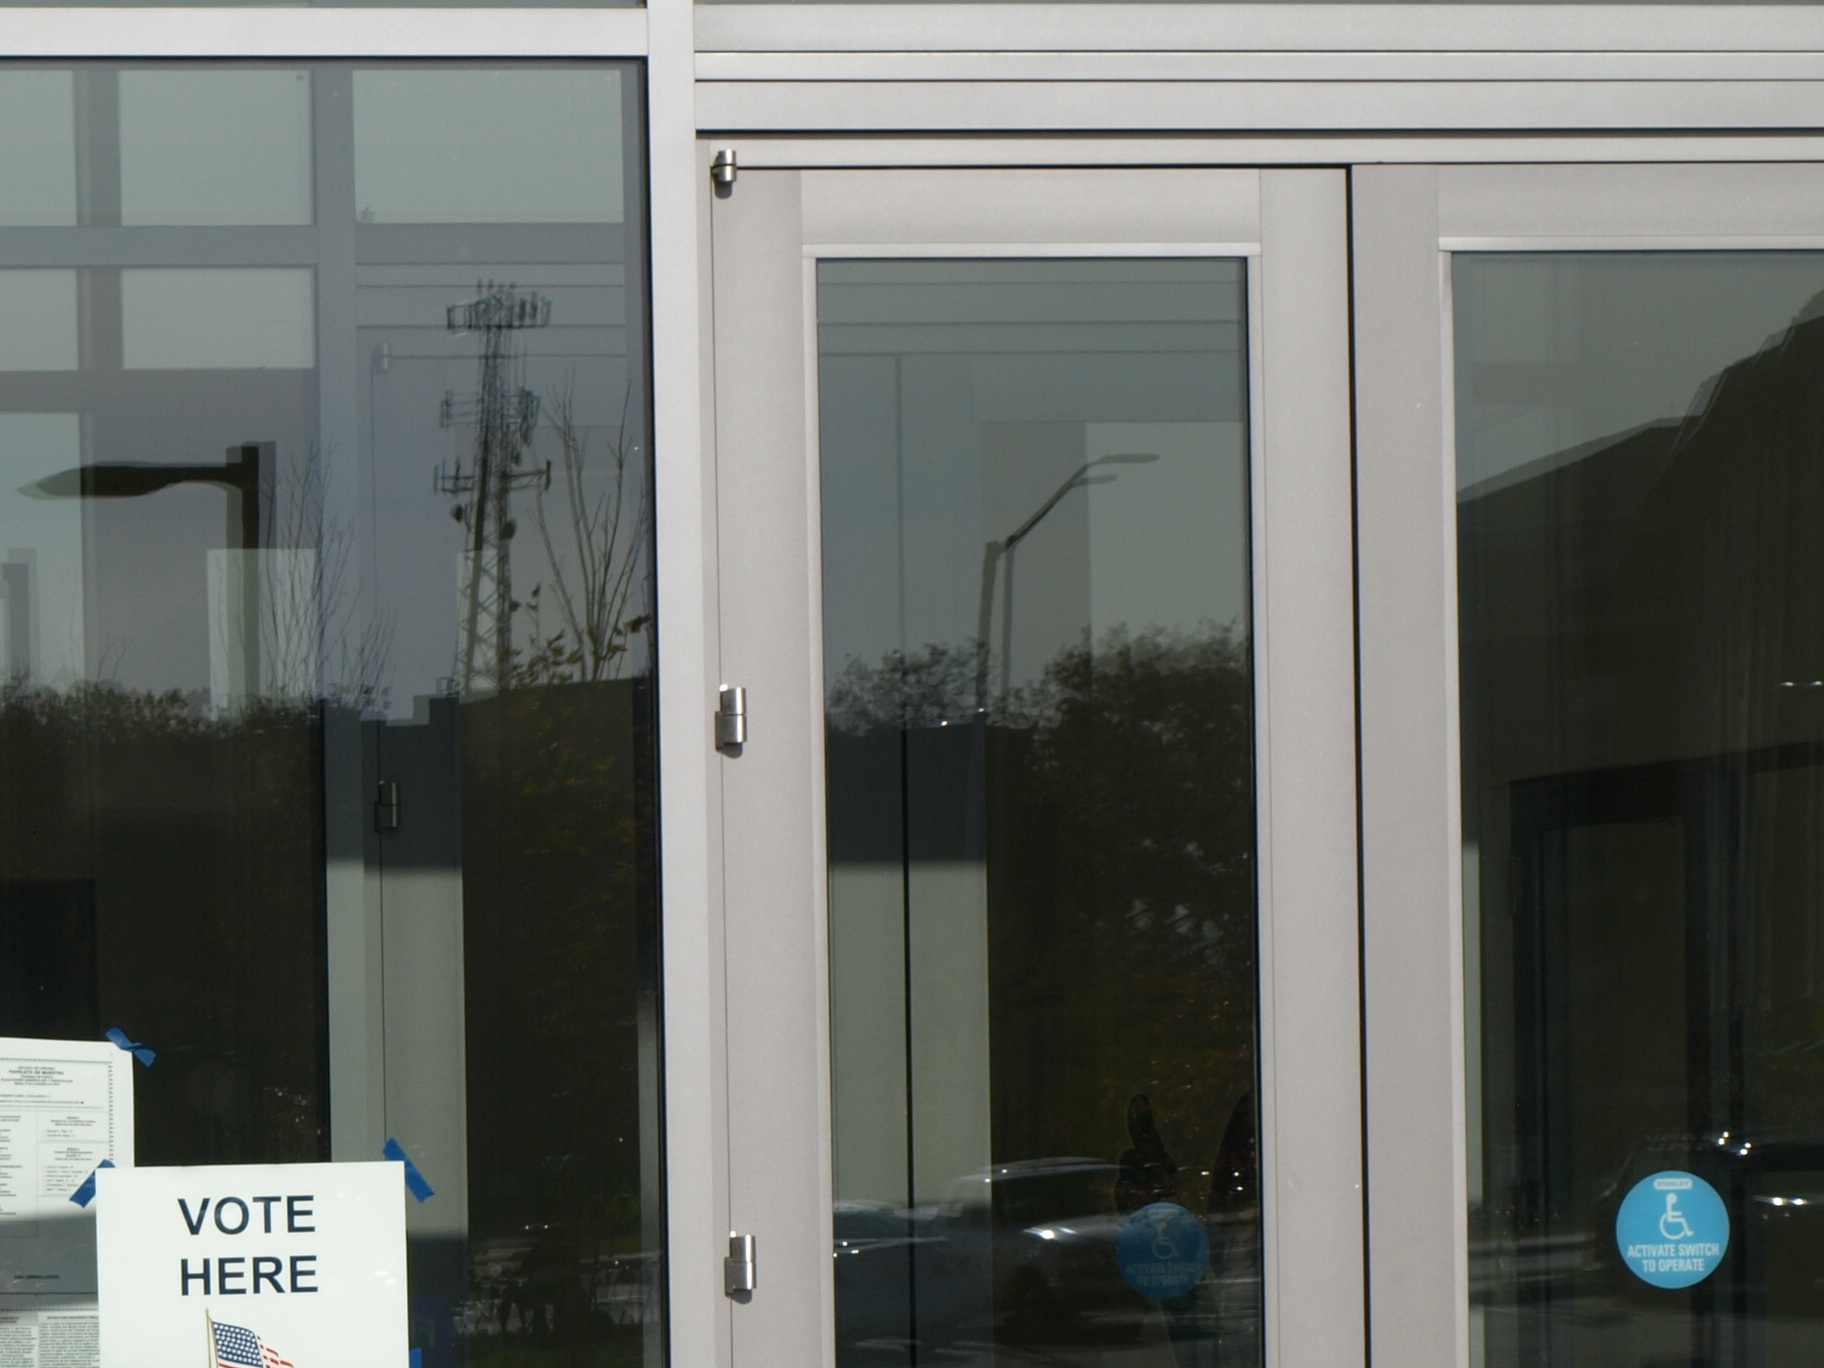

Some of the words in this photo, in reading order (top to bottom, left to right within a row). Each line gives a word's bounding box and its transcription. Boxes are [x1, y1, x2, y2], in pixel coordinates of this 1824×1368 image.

[1656, 1180, 1691, 1189] STANLEY
[178, 1195, 316, 1235] VOTE
[1627, 1243, 1676, 1258] ACTIVATE
[1678, 1242, 1720, 1257] SWITCH
[1642, 1259, 1656, 1272] TO
[1658, 1258, 1705, 1272] OPERATE
[181, 1256, 318, 1296] HERE
